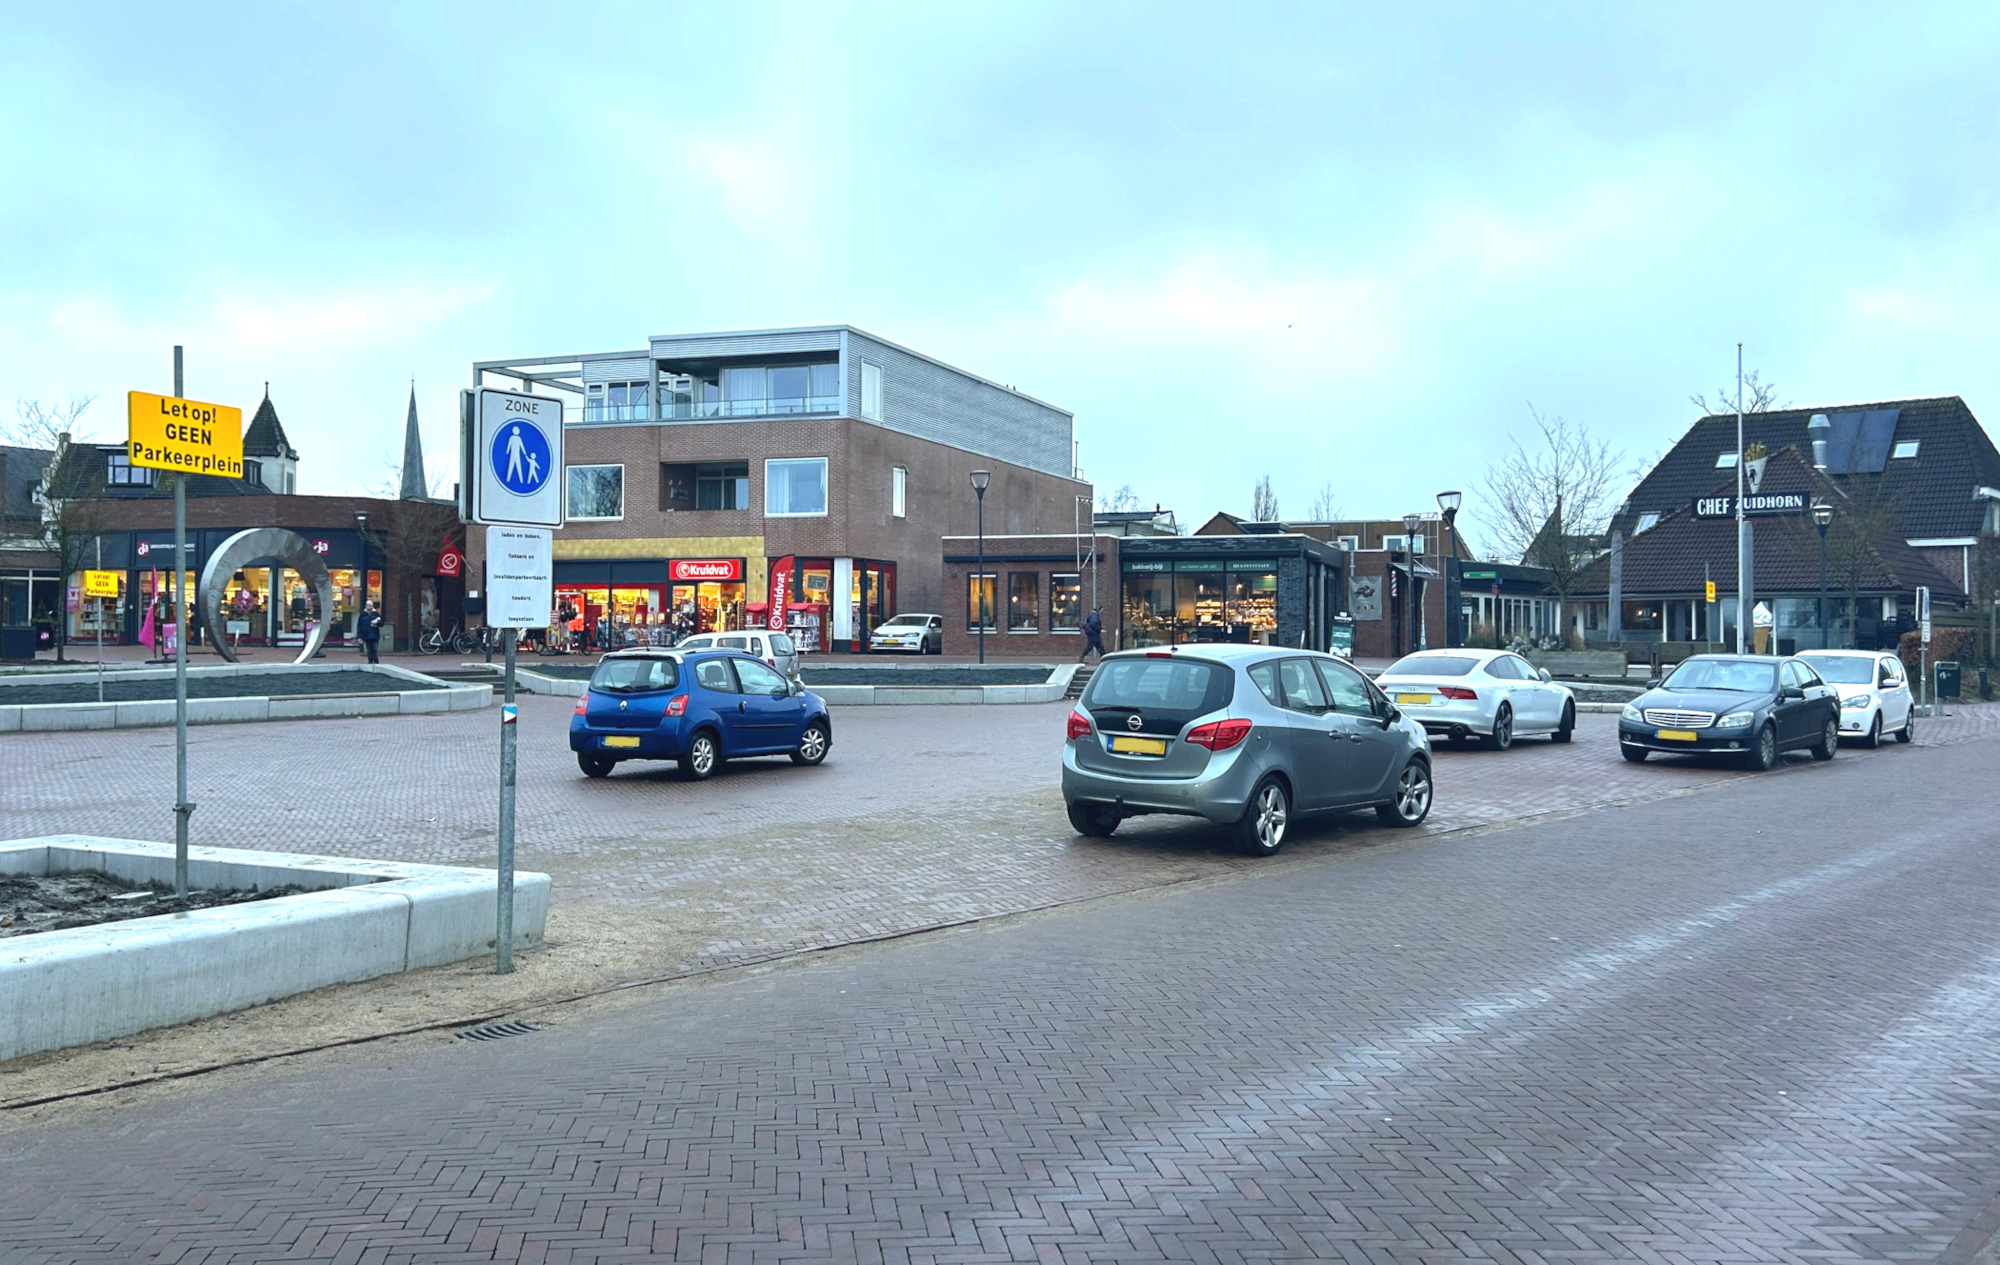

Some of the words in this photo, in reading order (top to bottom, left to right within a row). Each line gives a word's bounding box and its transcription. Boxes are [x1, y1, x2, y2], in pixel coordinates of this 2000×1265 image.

[161, 398, 188, 419] Let
[192, 407, 216, 426] op!
[505, 399, 539, 415] ZONE
[165, 423, 212, 446] GEEN
[133, 441, 241, 474] Parkeerplein
[1697, 498, 1730, 515] CHEF
[690, 564, 729, 576] Kruidvat
[772, 571, 786, 616] Kruidvat
